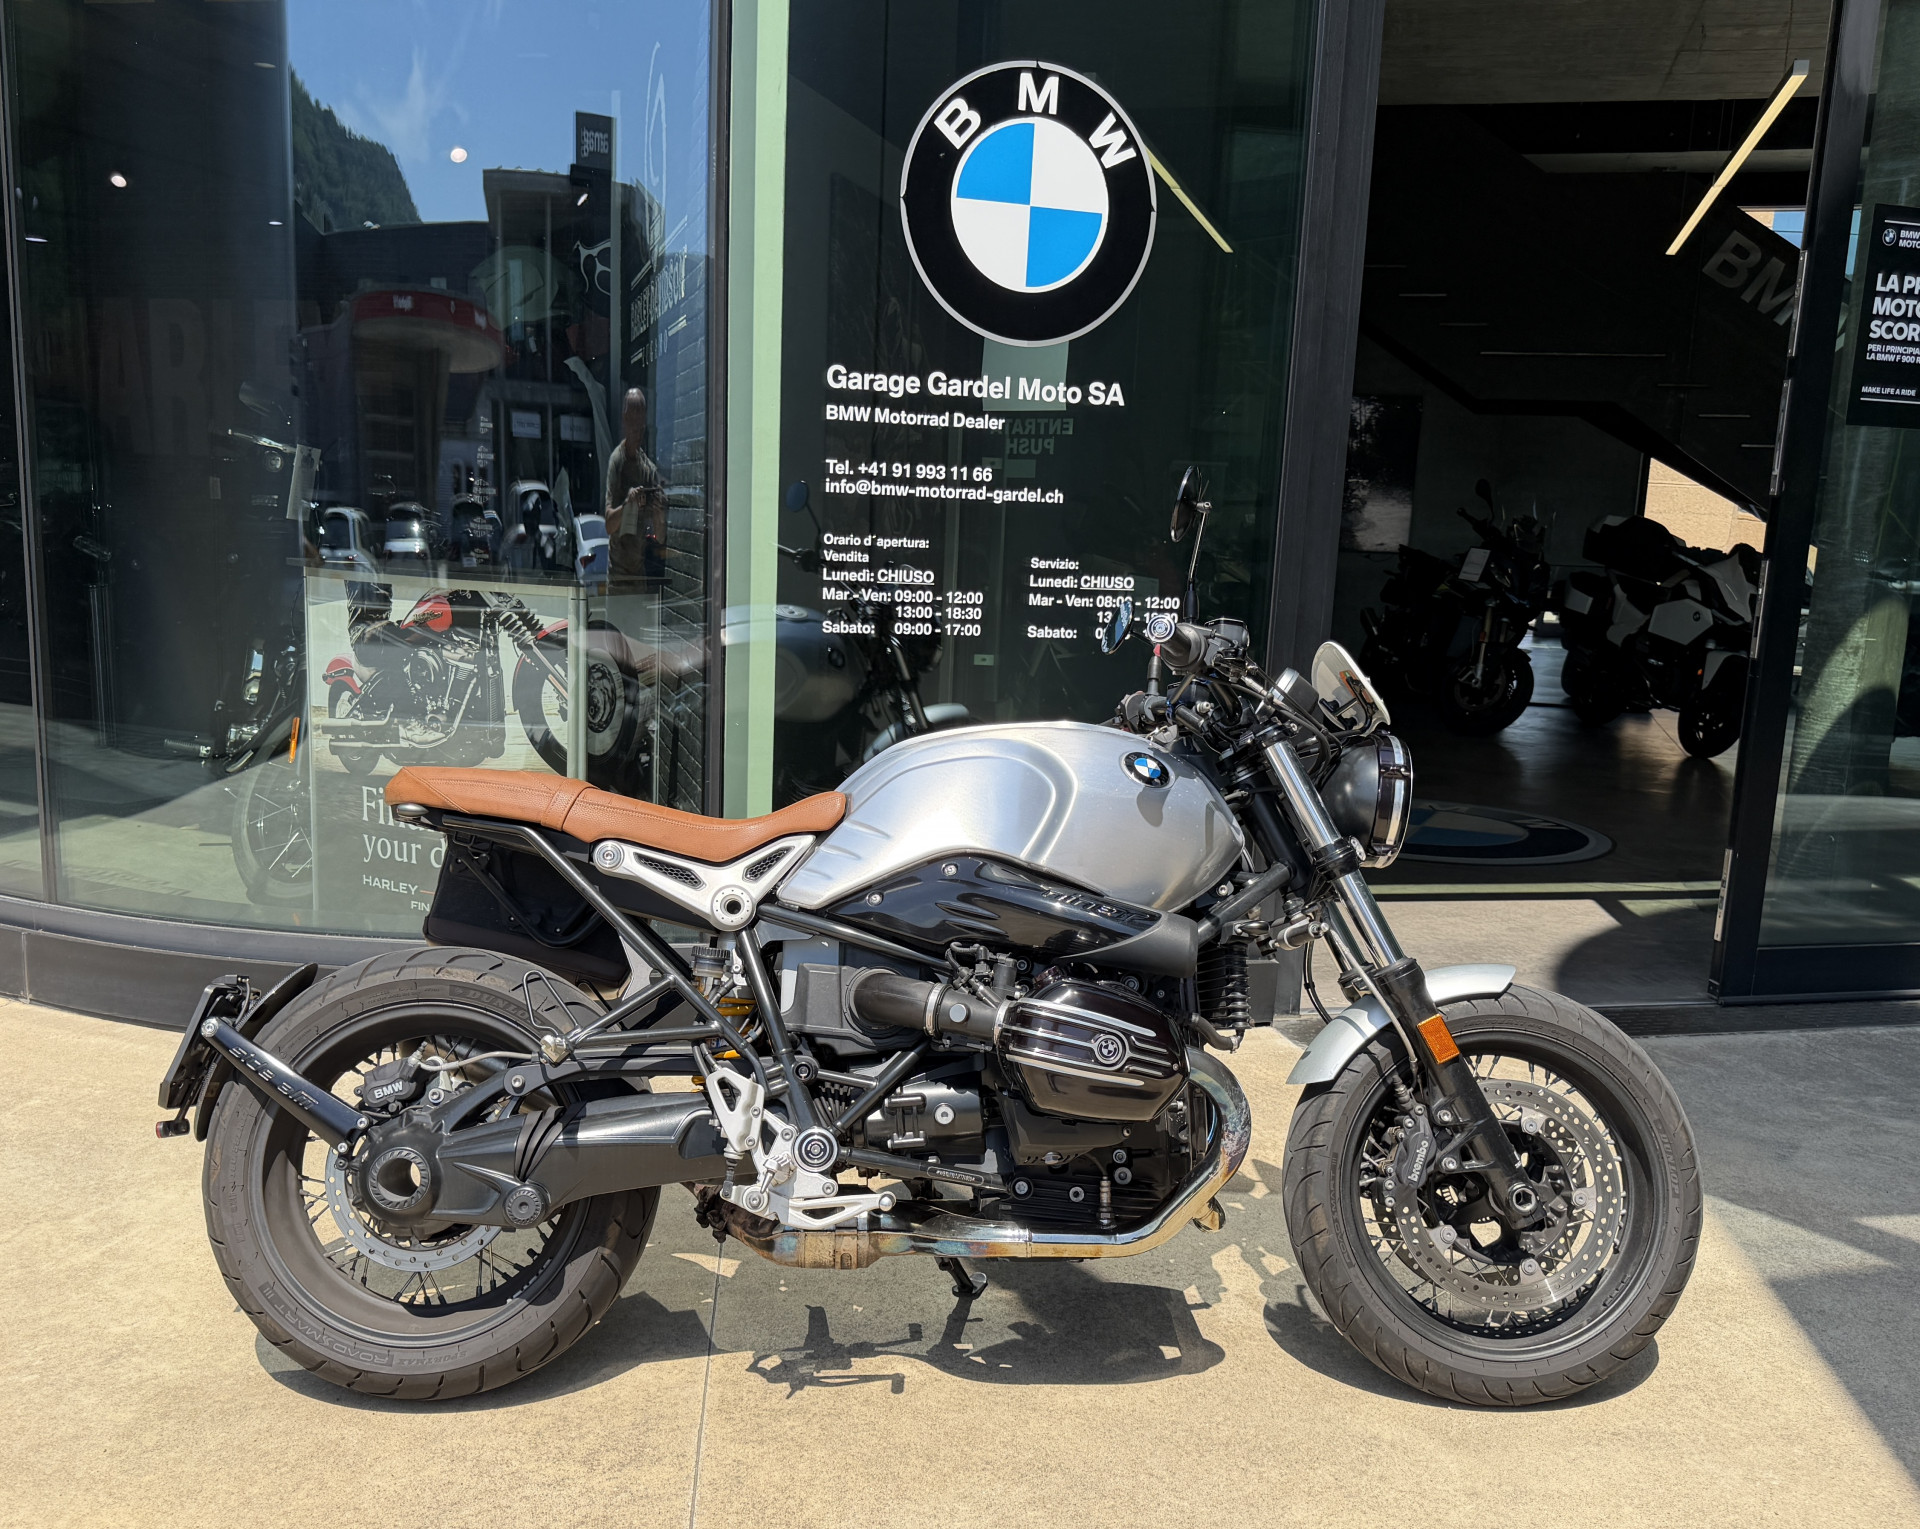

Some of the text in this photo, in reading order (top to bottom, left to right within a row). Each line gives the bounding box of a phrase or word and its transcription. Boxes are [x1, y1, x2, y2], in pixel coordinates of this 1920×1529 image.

[934, 72, 1137, 169] BMW
[1900, 230, 1920, 239] BMW
[1876, 273, 1899, 293] LA
[1876, 353, 1895, 362] BMW
[1901, 355, 1915, 363] 900
[826, 364, 1125, 406] Garage Gardel Moto SA
[1862, 386, 1880, 394] MAKE
[1882, 387, 1894, 395] LIFE
[825, 404, 1005, 430] BMW Motorrad Dealer
[825, 459, 993, 482] Tel. +41 91 993 11 66
[825, 478, 1064, 504] info@bmw-motorrad-gardel.ch
[823, 533, 861, 546] Orario
[823, 550, 869, 563] Vendita
[1030, 557, 1079, 570] Servizio:
[822, 568, 935, 584] Lunedì: CHIUSO
[1029, 574, 1134, 590] Lunedì: CHIUSO
[822, 587, 850, 600] Mar
[861, 588, 891, 602] Ven:
[895, 590, 933, 603] 09:00
[946, 591, 983, 604] 12:00
[1028, 593, 1054, 606] Mar
[1065, 594, 1093, 607] Ven:
[1145, 597, 1180, 609] 12:00
[896, 606, 932, 618] 13:00
[946, 607, 982, 619] 18:30
[822, 621, 875, 634] Sabato:
[894, 623, 932, 635] 09:00
[945, 624, 981, 636] 17:00
[1027, 625, 1077, 639] Sabato:
[363, 834, 421, 863] your
[363, 874, 418, 895] HARLEY
[374, 1081, 403, 1098] BMW
[1407, 1140, 1428, 1181] brembo
